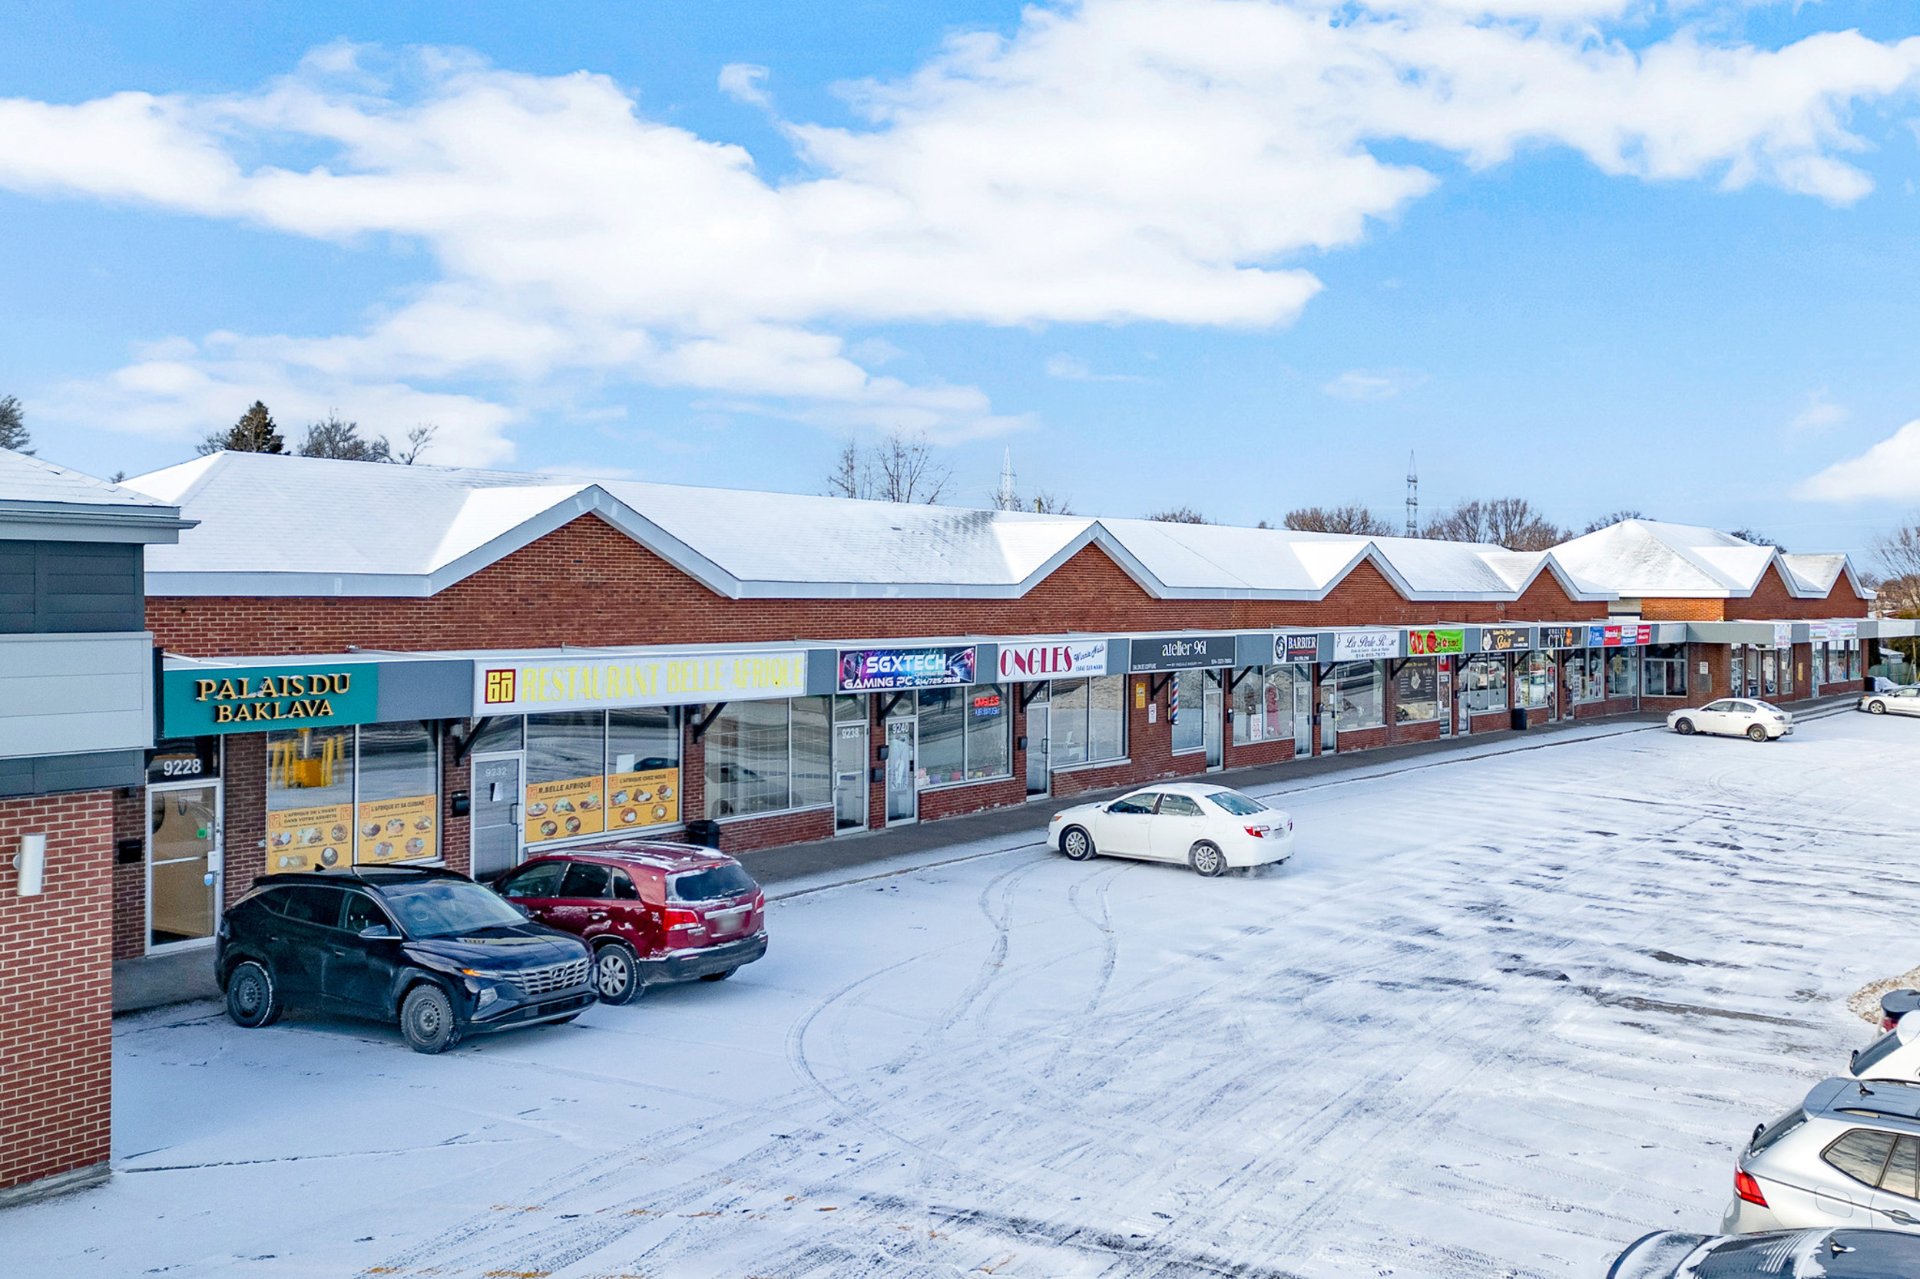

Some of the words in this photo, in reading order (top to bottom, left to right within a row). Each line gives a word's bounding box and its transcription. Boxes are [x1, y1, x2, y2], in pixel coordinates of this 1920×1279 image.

[1162, 640, 1192, 657] atelier
[1193, 640, 1207, 655] 961
[1288, 636, 1317, 650] BARBIER
[866, 653, 947, 674] SGXTECH
[1000, 645, 1073, 677] ONGLES
[195, 675, 304, 701] PALAIS
[307, 672, 352, 696] DU
[521, 664, 660, 703] RESTAURANT
[666, 658, 725, 693] BELLE
[732, 655, 803, 689] AFRIQUE
[843, 677, 894, 690] GAMING
[896, 675, 913, 687] PC
[215, 699, 334, 723] BAKLAVA
[841, 727, 860, 740] 9238
[892, 723, 910, 735] 9240
[163, 758, 201, 777] 9228
[485, 767, 508, 778] 9232
[565, 780, 592, 790] AFRIQUE
